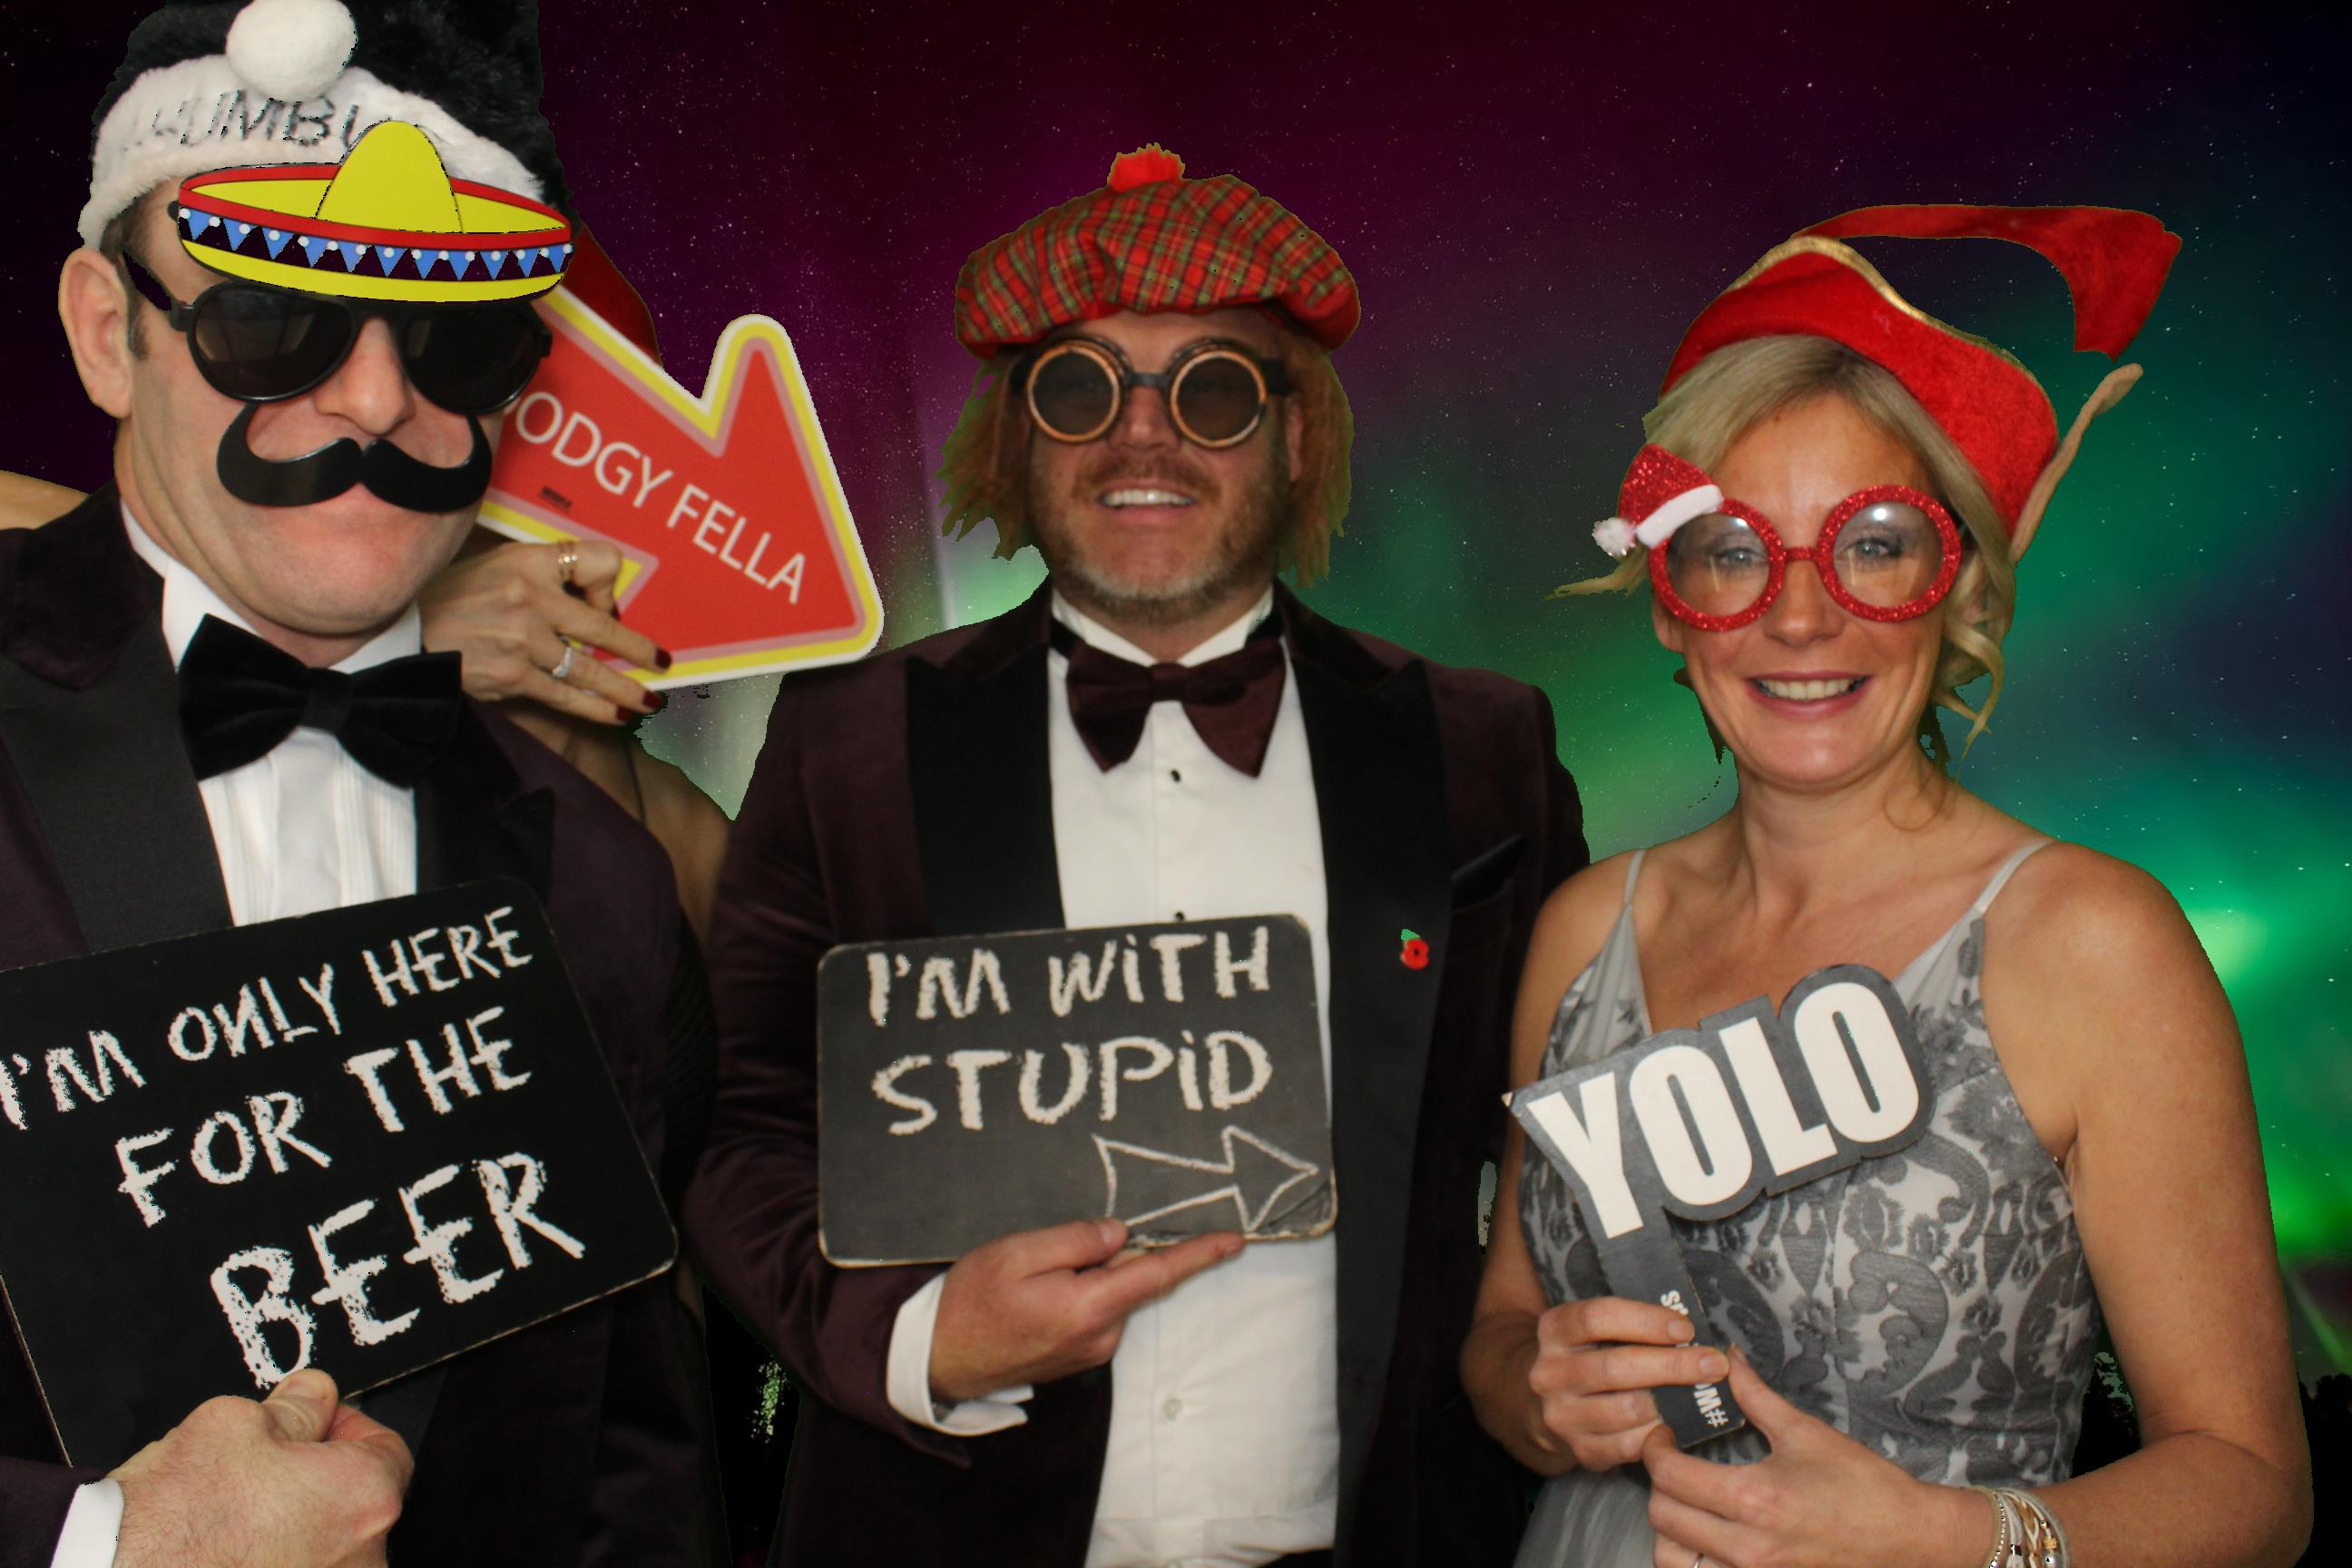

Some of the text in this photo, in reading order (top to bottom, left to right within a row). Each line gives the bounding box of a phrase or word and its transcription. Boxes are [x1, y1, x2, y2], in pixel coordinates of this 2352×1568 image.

[504, 391, 807, 604] ODGY FELLA
[0, 906, 533, 1131] I'M ONLY HERE
[867, 948, 1011, 1026] I'M
[114, 1005, 532, 1228] FOR THE
[1525, 981, 1920, 1240] YOLO
[210, 1152, 585, 1390] BEER
